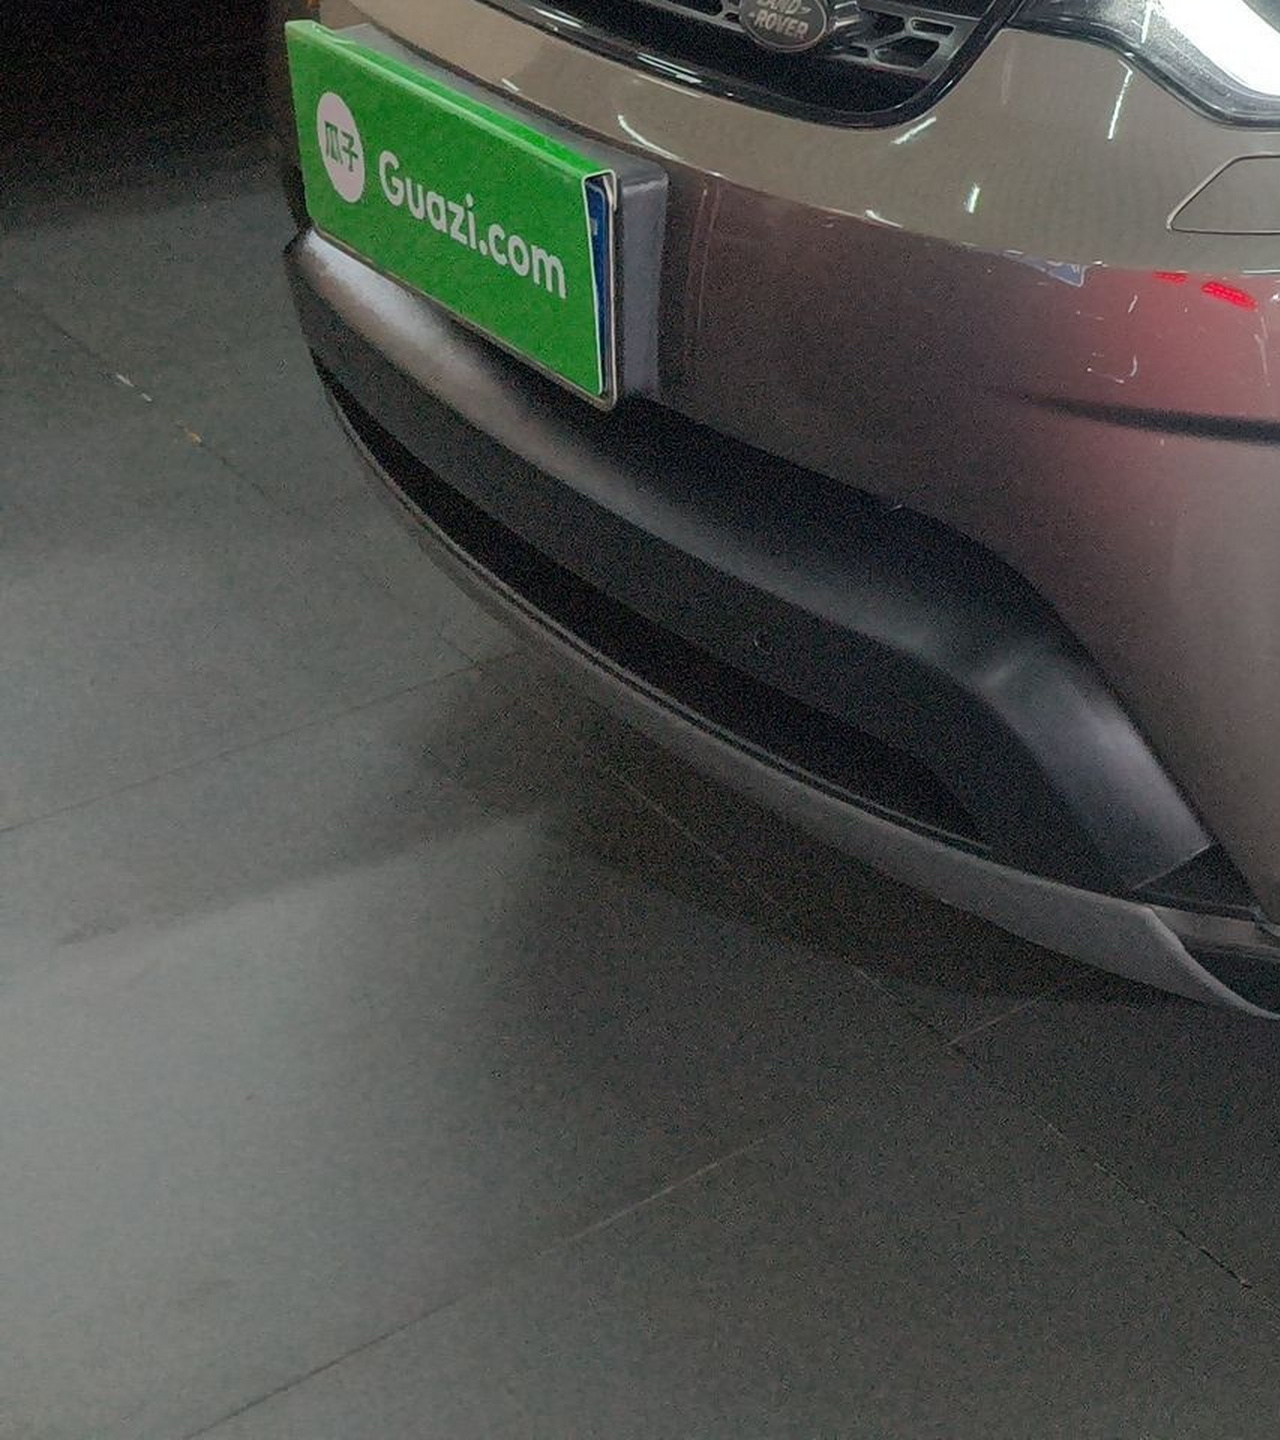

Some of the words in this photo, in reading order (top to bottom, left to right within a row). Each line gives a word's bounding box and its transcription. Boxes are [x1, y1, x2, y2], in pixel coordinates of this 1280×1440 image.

[753, 8, 809, 40] ROVER
[324, 120, 360, 173] 瓜子
[378, 150, 567, 300] Guazi.com
